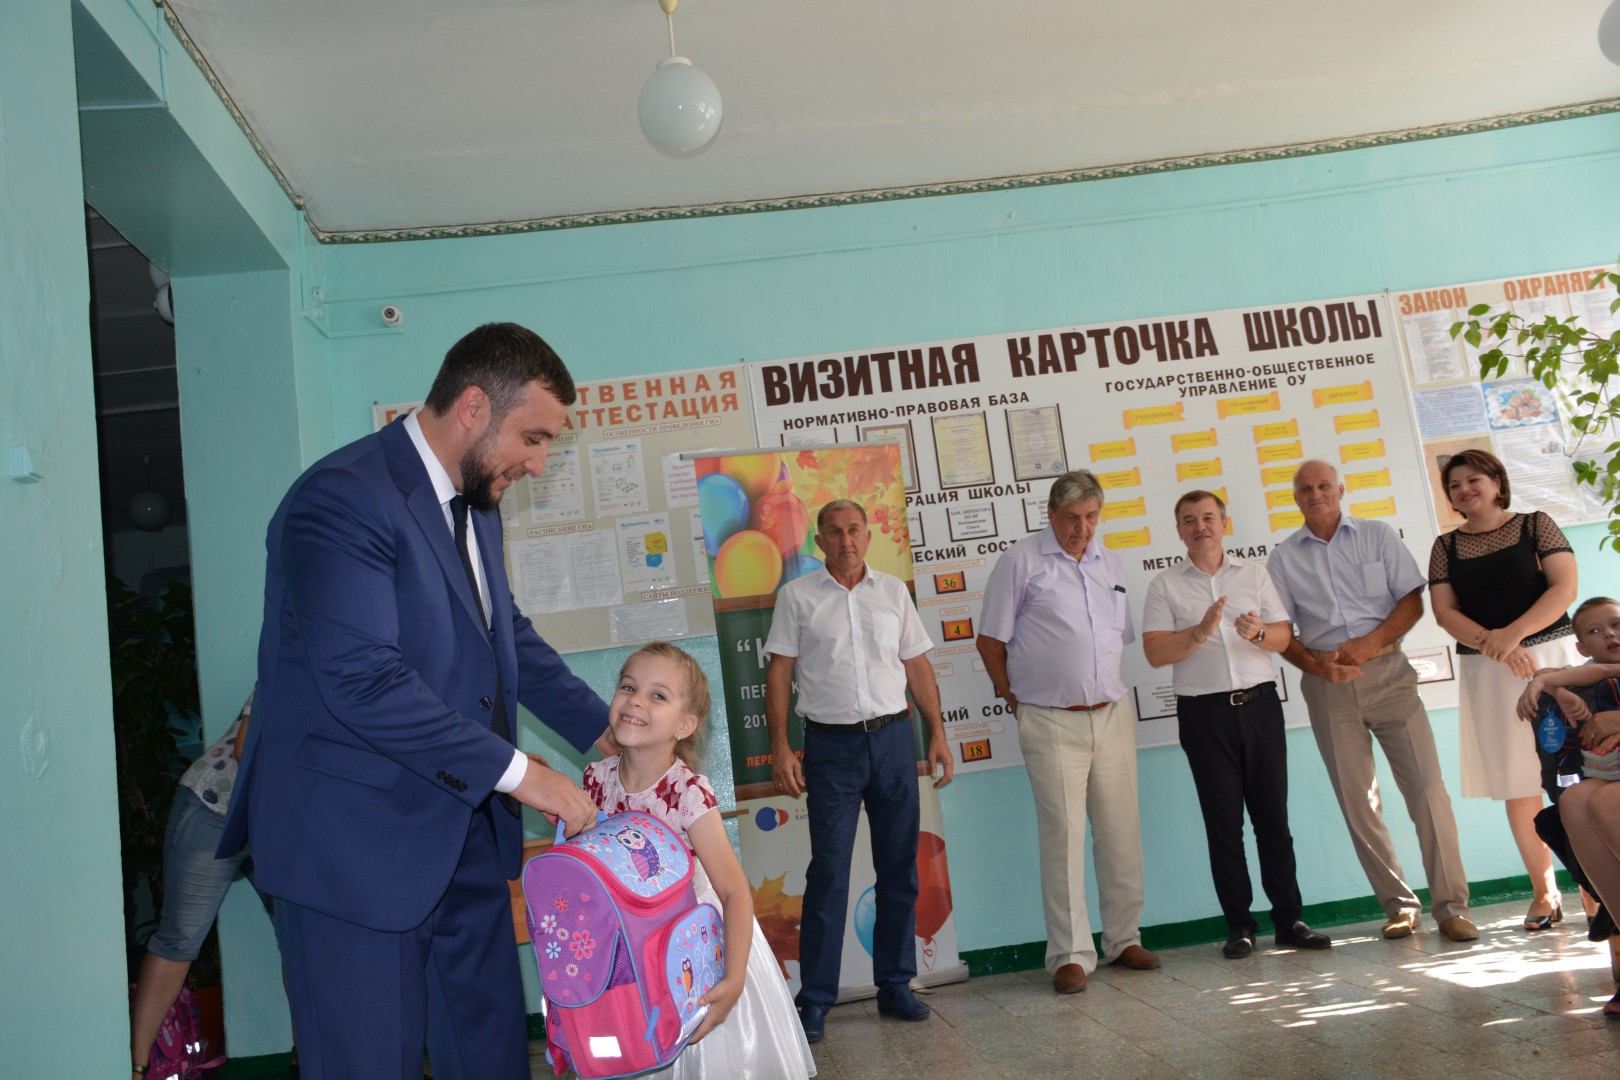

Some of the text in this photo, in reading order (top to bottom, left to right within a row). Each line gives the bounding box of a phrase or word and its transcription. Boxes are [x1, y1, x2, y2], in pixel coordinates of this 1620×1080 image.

[1398, 268, 1606, 316] ЗАКОН ОХРАНЯЕТ
[761, 299, 1383, 407] ВИЗИТНАЯ КАРТОЧКА ШКОЛЫ
[1105, 353, 1376, 393] ГОСУДАРСТВЕННО-ОБЩЕСТВЕННОЕ
[1178, 374, 1307, 399] УПРАВЛЕНИЕ ОУ
[783, 391, 1030, 430] НОРМАТИВНО-ПРАВОВАЯ БАЗА
[605, 426, 658, 438] ОСОБЕННОСТИ
[704, 417, 720, 427] ГИА
[968, 482, 1031, 499] ШКОЛЫ
[529, 525, 577, 536] РАСПИСАНИЕ
[911, 544, 967, 564] ЕСКИЙ
[943, 578, 956, 589] 36
[954, 625, 961, 635] 4
[969, 746, 982, 757] 18
